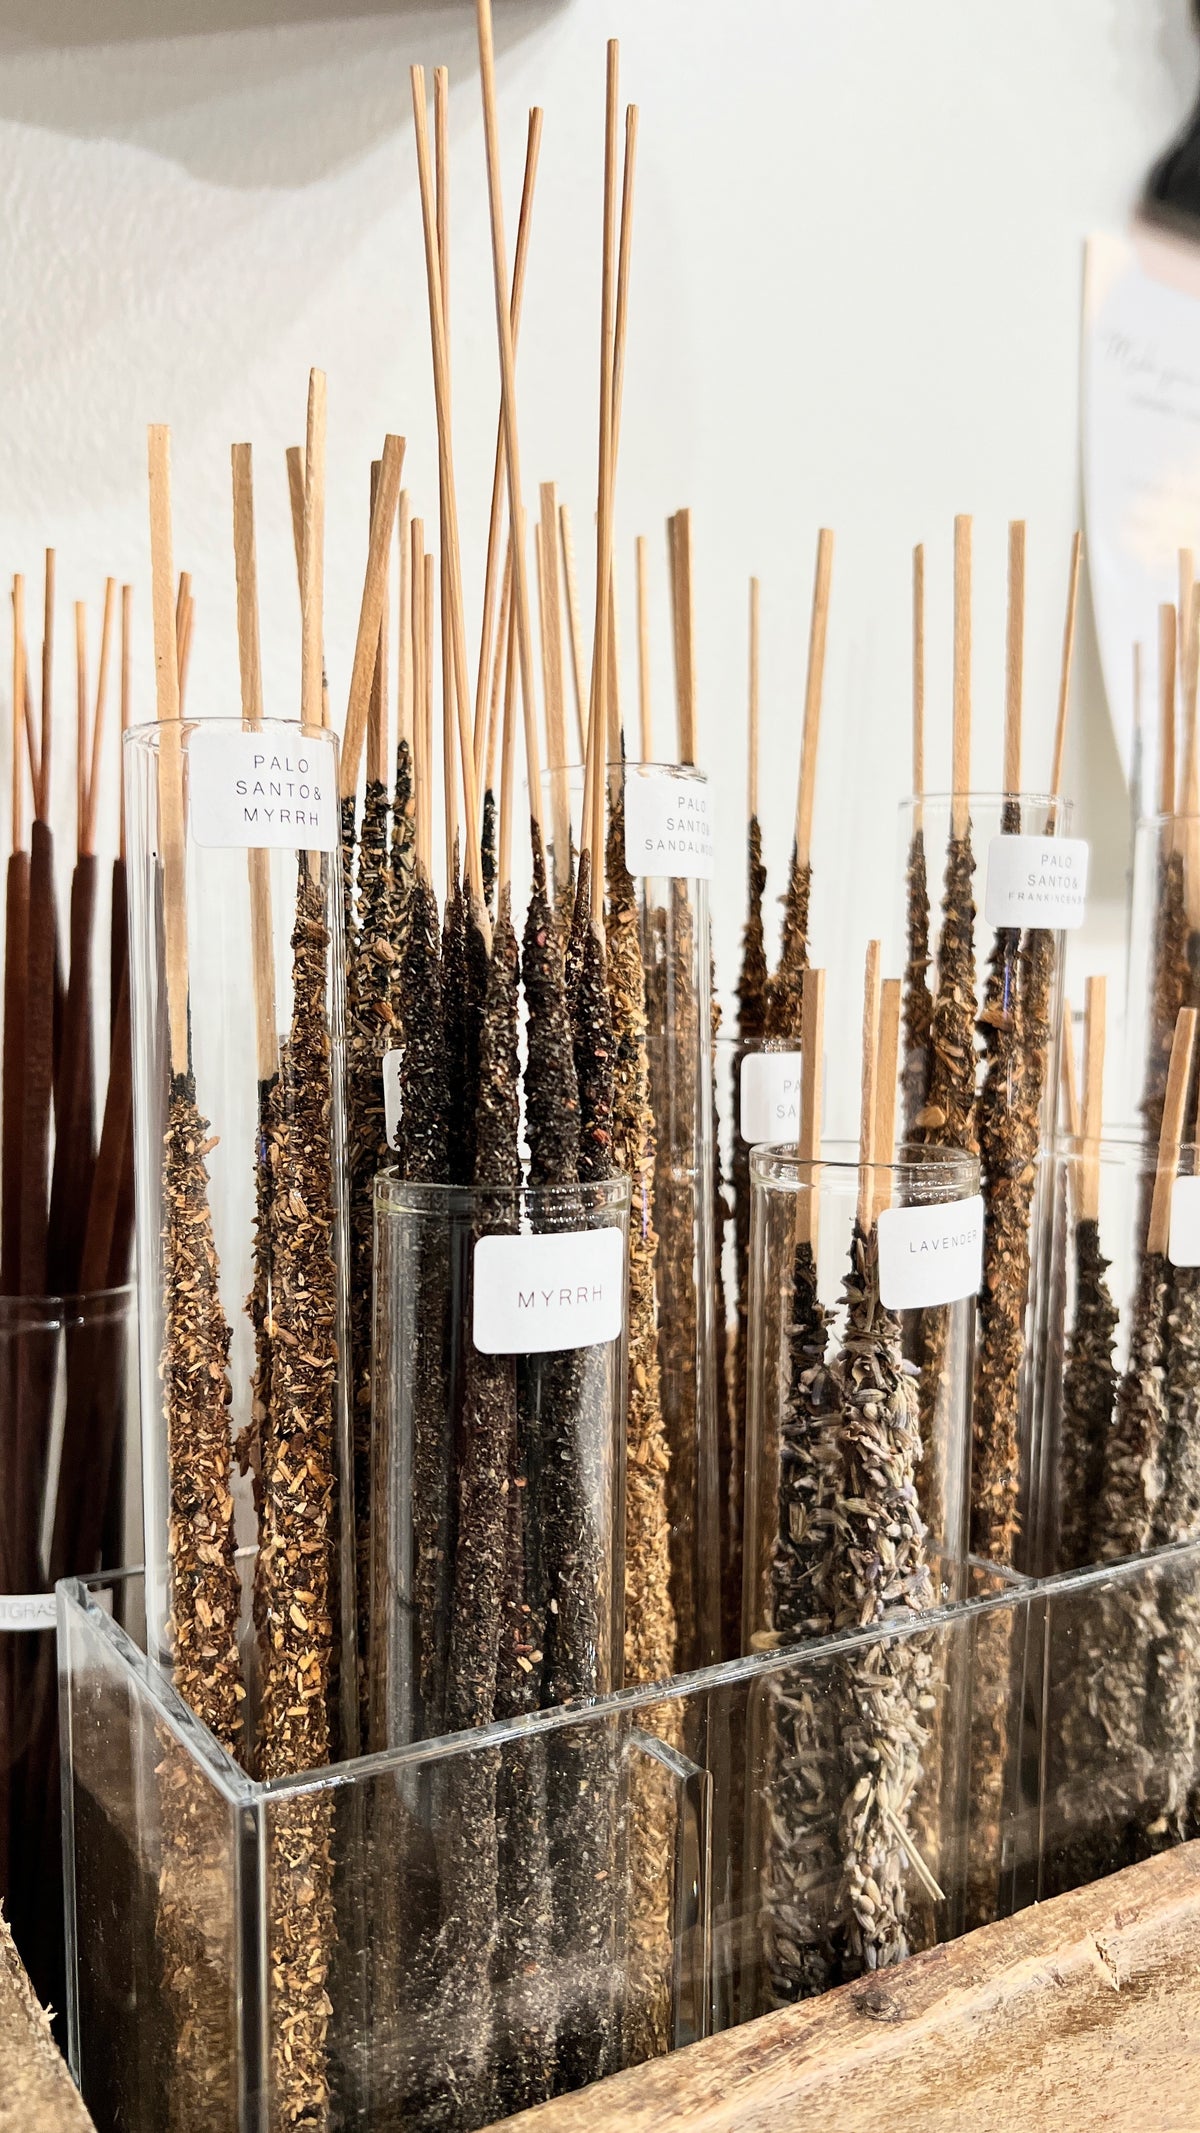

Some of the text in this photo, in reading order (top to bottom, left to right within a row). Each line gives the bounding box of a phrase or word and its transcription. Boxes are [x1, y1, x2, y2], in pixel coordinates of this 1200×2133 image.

[254, 755, 309, 773] PALO
[236, 780, 321, 801] SANTO&
[678, 796, 706, 813] PALO
[244, 807, 319, 826] MYRRH
[1041, 854, 1072, 869] PALO
[1027, 874, 1079, 889] SANTO&
[783, 1080, 801, 1093] PA
[909, 1229, 977, 1253] LAVENDER
[518, 1284, 602, 1308] MYRRH
